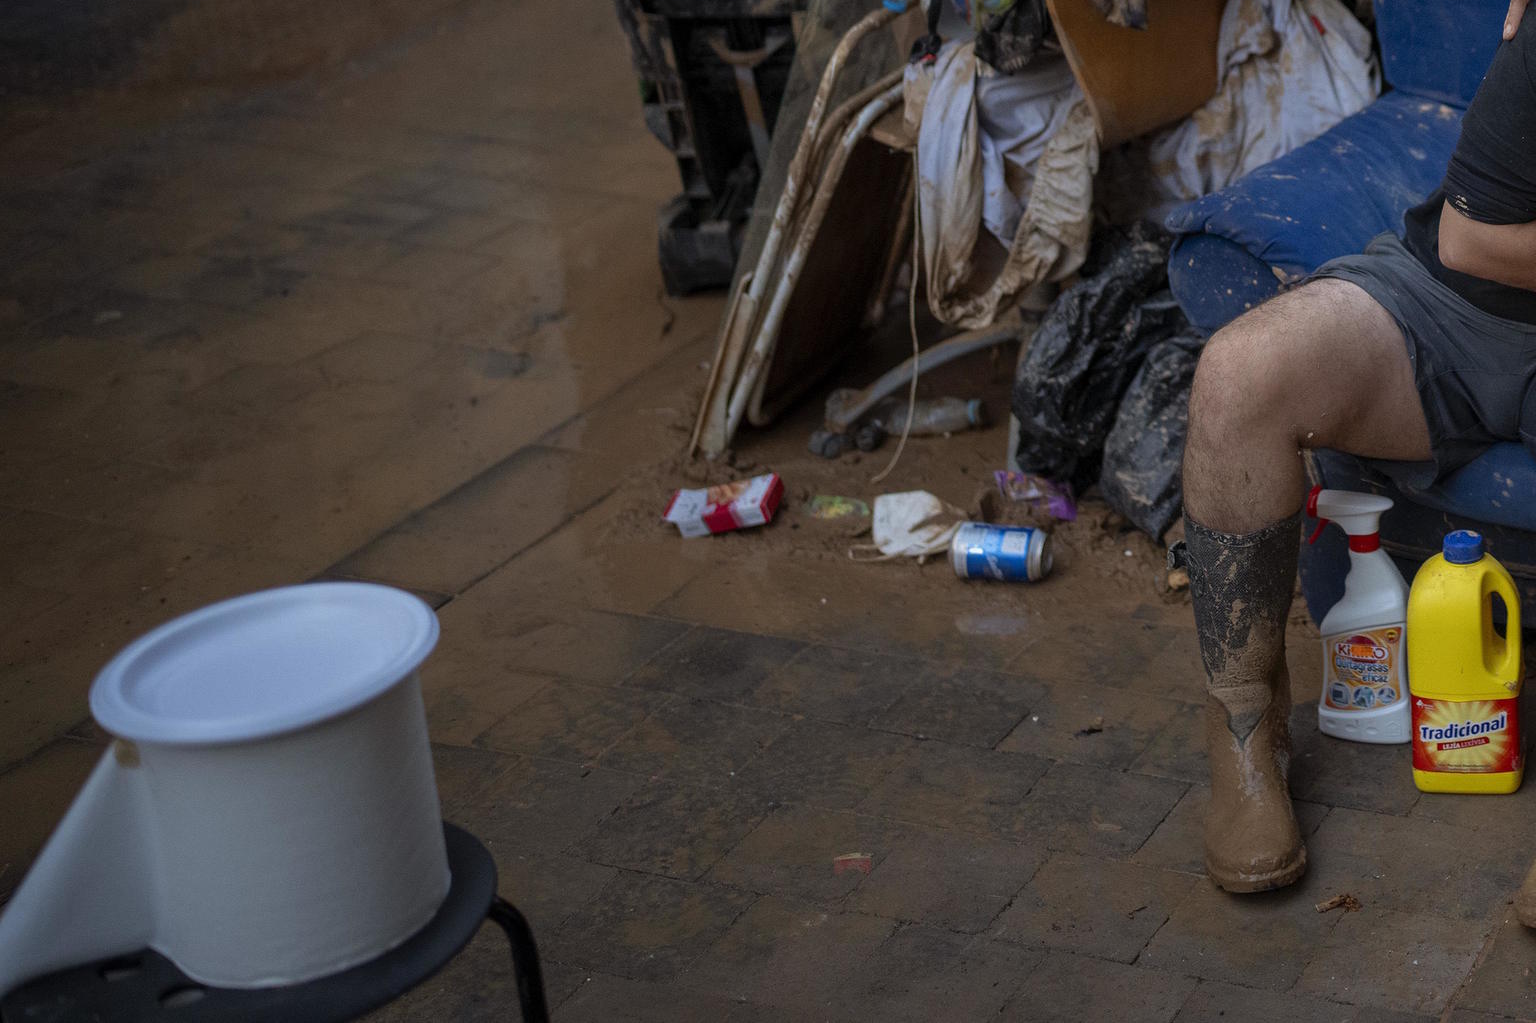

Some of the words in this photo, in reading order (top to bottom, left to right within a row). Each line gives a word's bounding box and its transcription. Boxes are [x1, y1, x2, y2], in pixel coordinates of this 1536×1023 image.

[1335, 656, 1389, 673] Quitagrasas
[1362, 671, 1388, 682] eficaz
[1420, 714, 1505, 740] Tradicional
